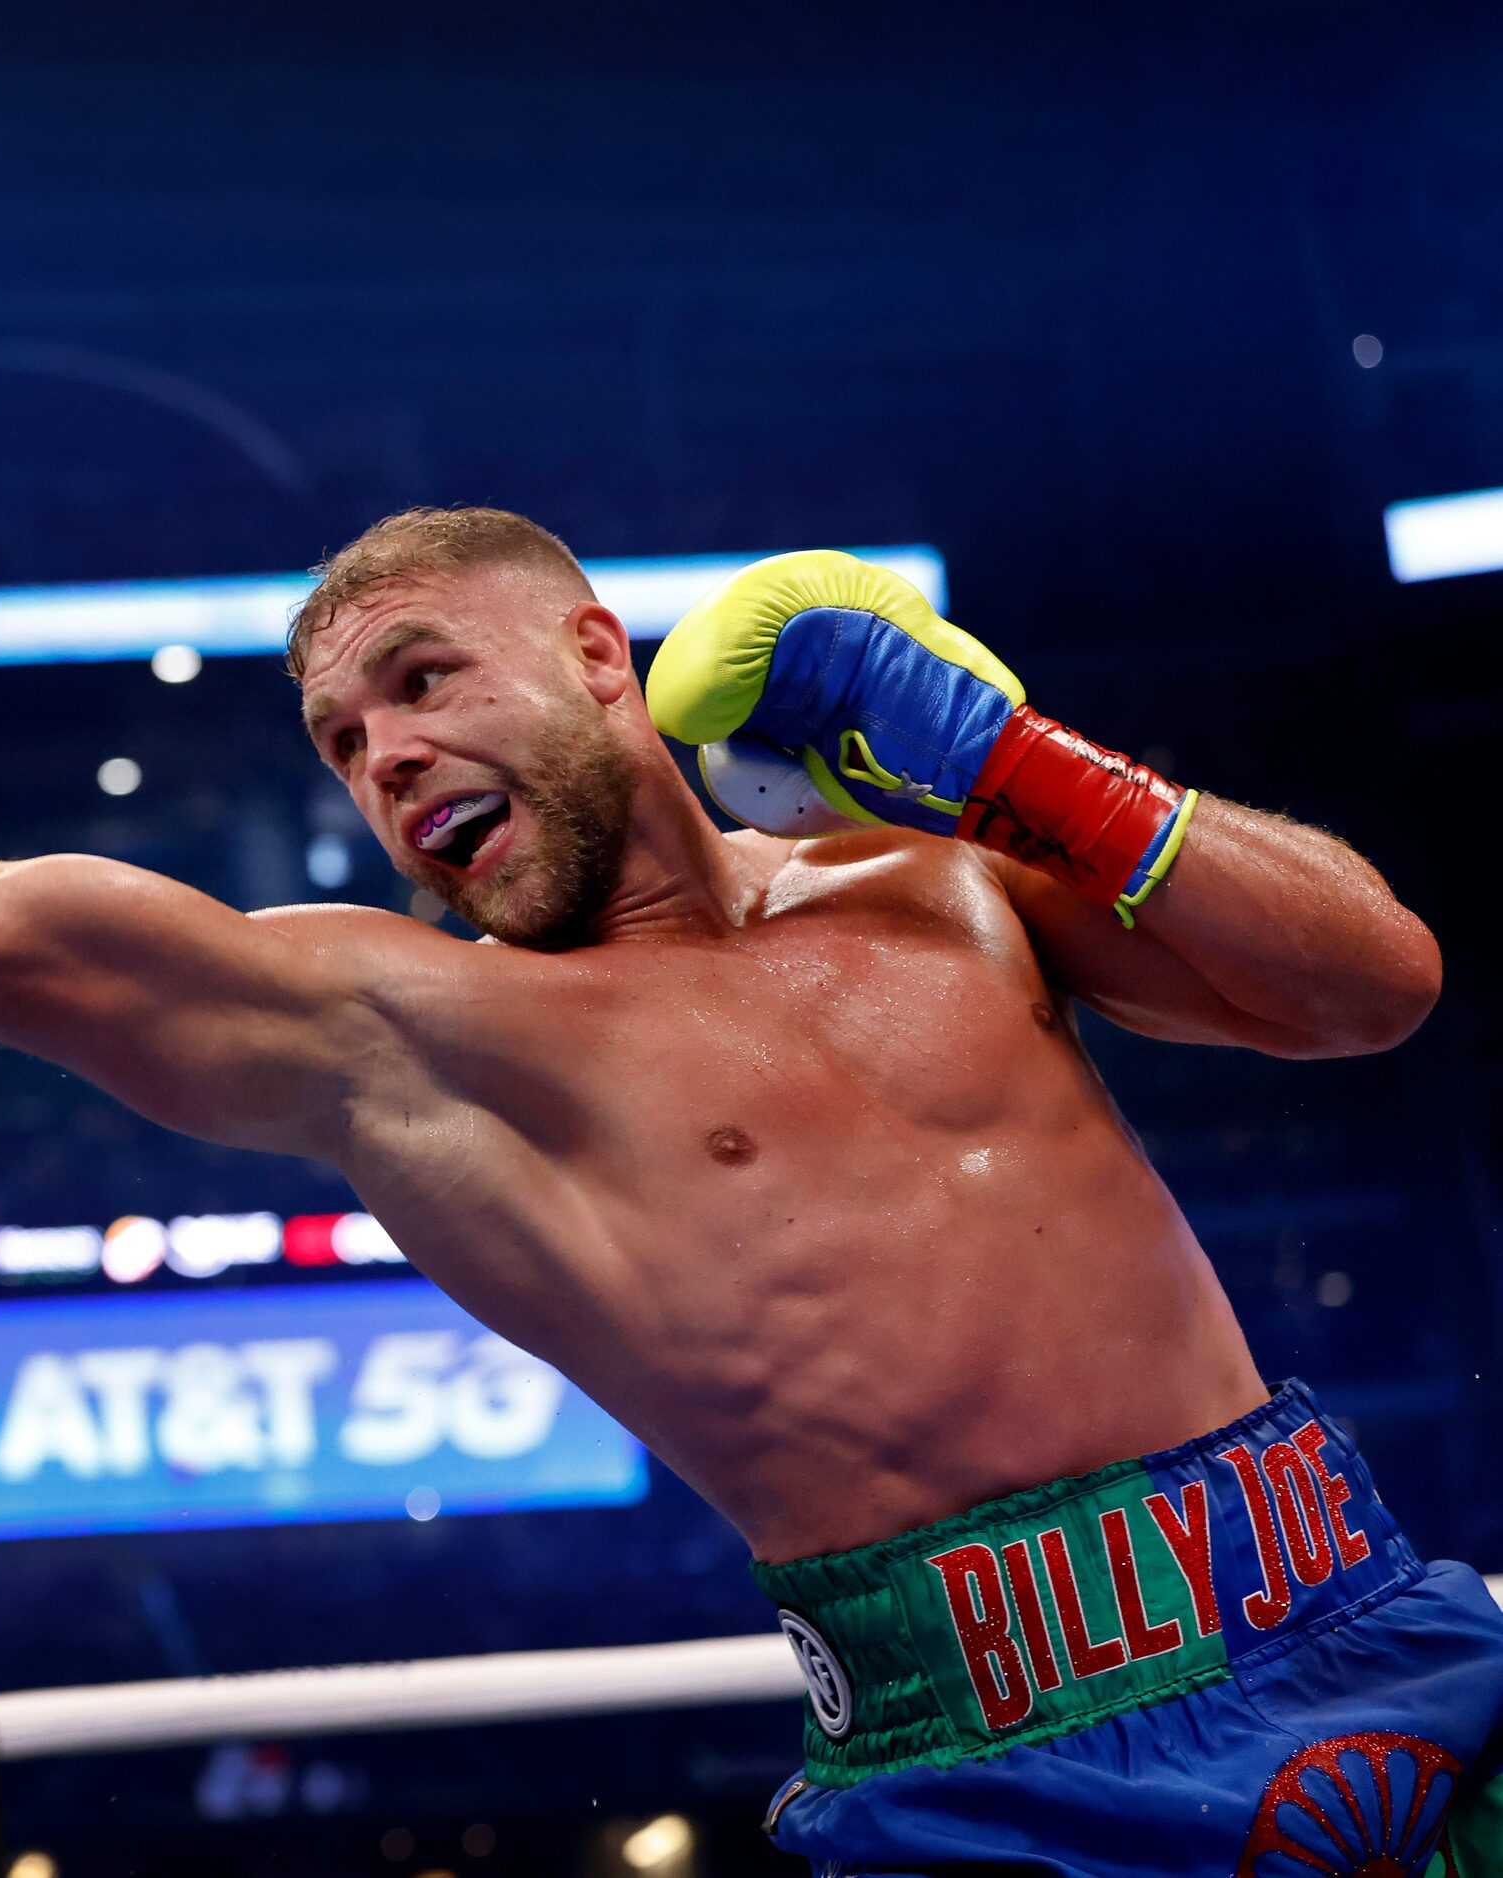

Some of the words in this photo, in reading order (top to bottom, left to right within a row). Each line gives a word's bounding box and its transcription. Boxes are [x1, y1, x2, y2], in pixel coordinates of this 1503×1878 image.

[339, 1329, 563, 1466] 5G
[926, 1479, 1224, 1732] BILLY
[1214, 1419, 1372, 1632] JOE
